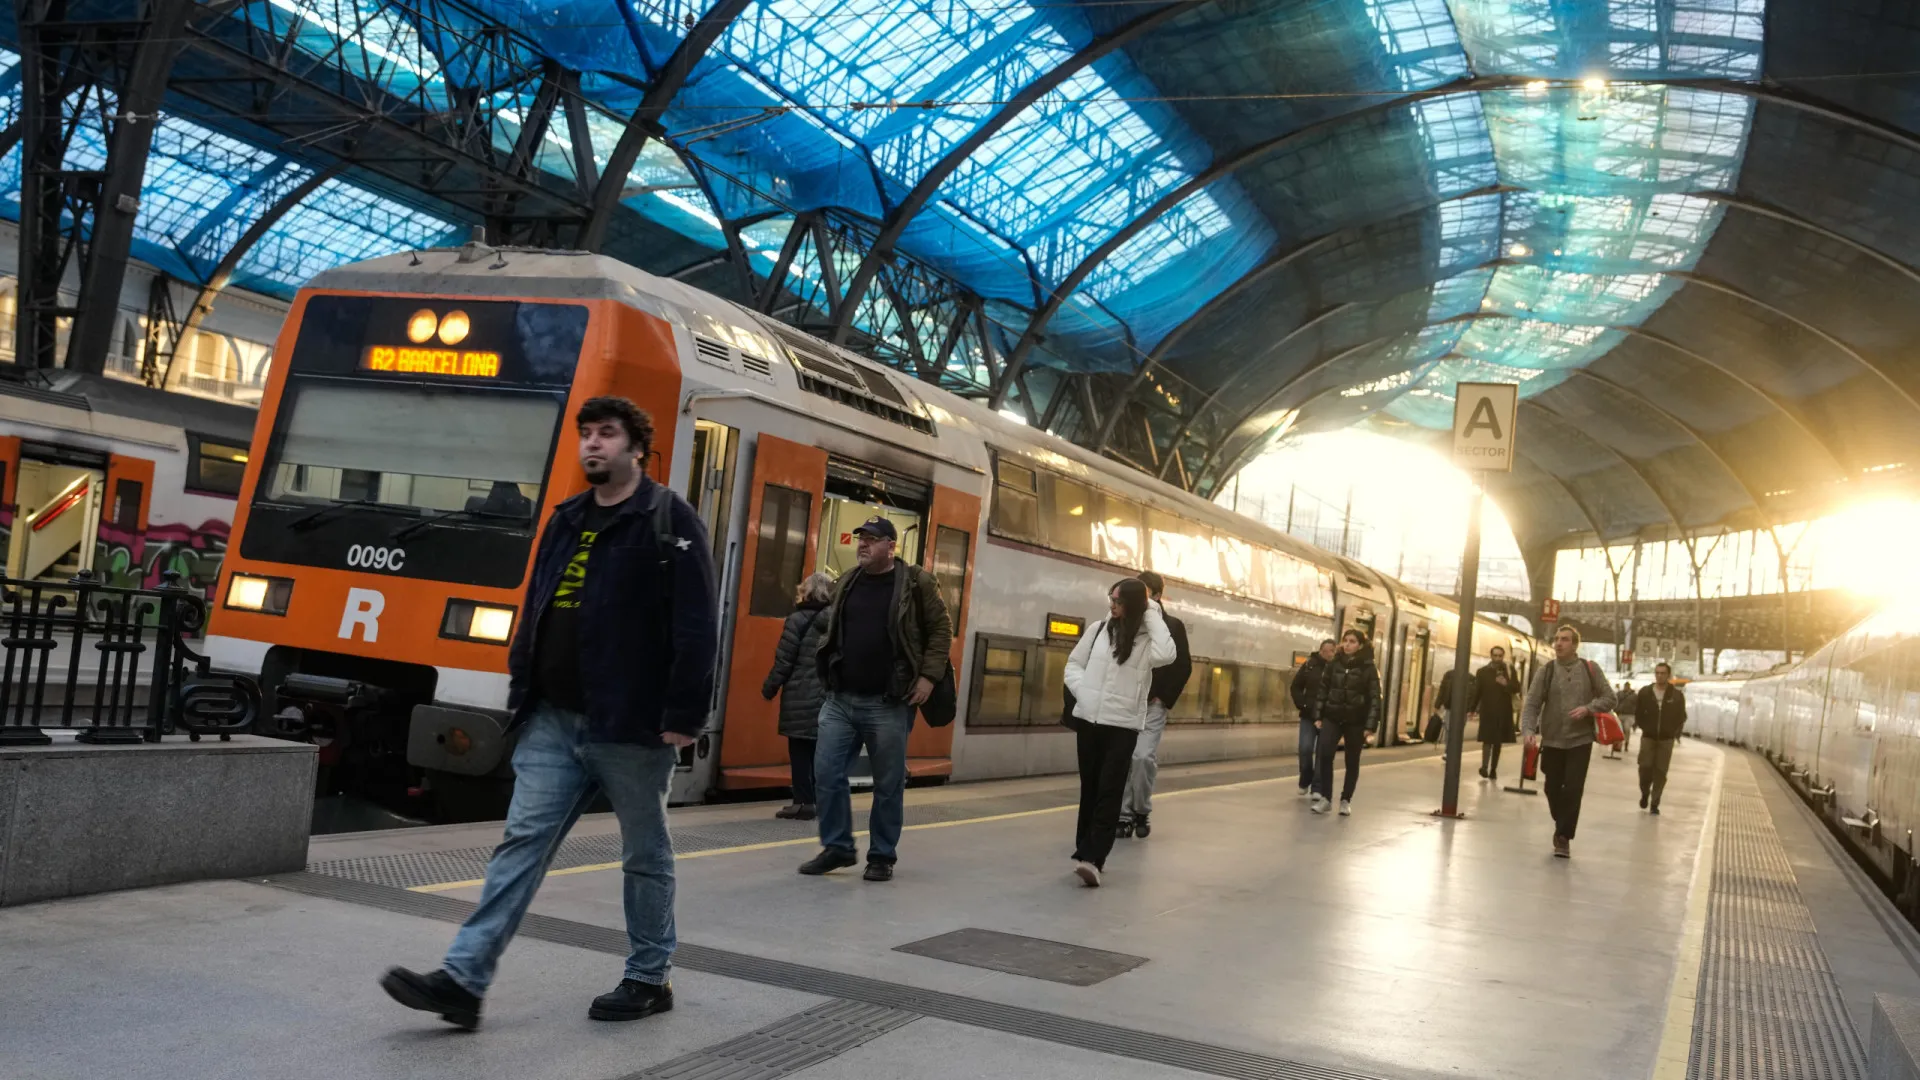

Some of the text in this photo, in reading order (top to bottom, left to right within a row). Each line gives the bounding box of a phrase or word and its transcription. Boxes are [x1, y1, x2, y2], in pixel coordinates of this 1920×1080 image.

[372, 347, 498, 377] R2 BARCELONA
[1463, 396, 1503, 439] A
[1456, 446, 1506, 457] SECTOR
[347, 544, 406, 571] 009C
[338, 587, 385, 642] R
